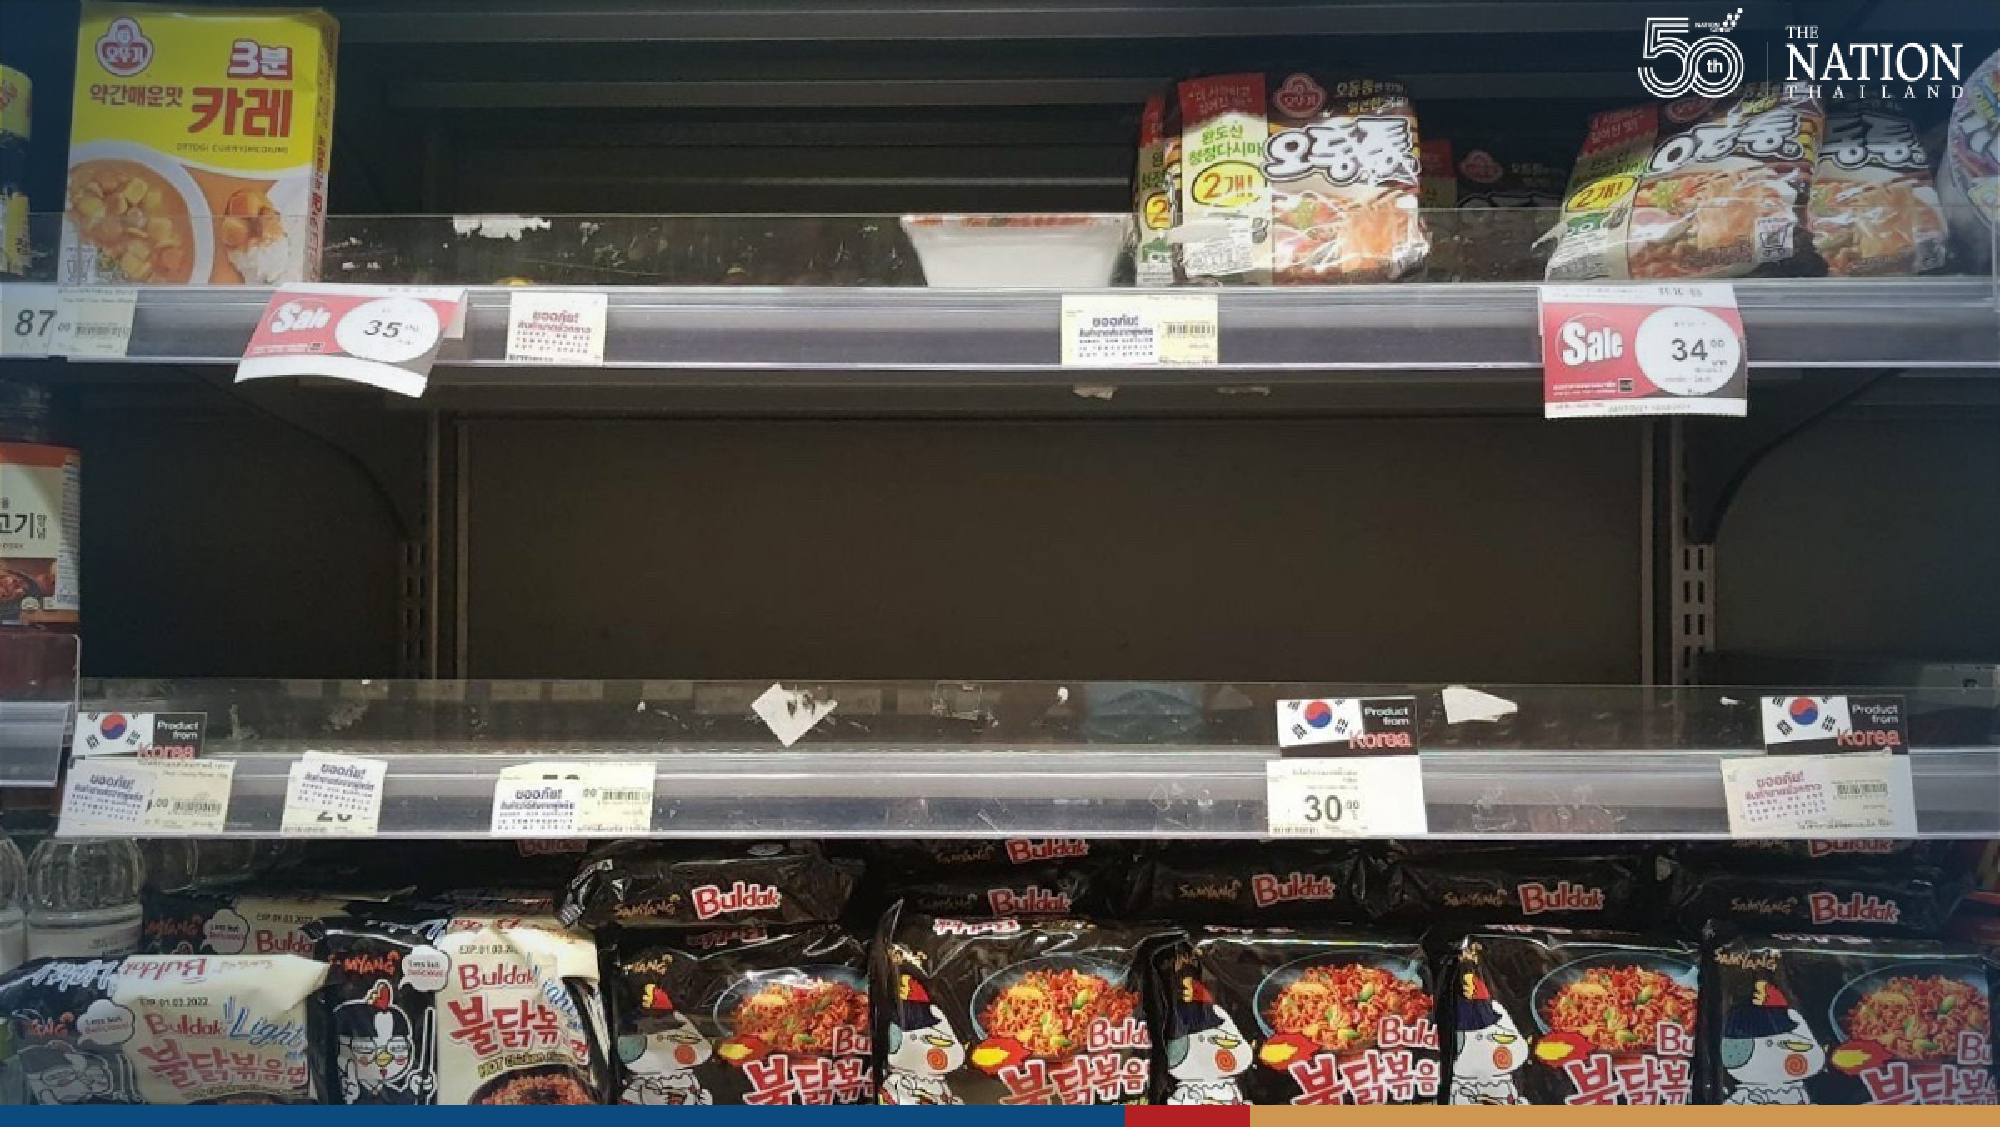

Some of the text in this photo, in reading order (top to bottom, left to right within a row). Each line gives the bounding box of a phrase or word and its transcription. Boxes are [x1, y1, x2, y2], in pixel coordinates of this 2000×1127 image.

[228, 39, 293, 80] 3분
[89, 84, 183, 107] 약간매운맛
[188, 87, 293, 138] 카레
[1203, 173, 1253, 198] 2개!
[14, 309, 58, 337] 87
[271, 301, 332, 334] Sale
[363, 320, 403, 338] 35
[1562, 321, 1623, 366] Sale
[1671, 338, 1708, 361] 34
[1364, 706, 1409, 716] Product
[1383, 717, 1411, 726] from
[1852, 704, 1898, 714] Product
[1872, 714, 1899, 724] from
[157, 721, 199, 731] Product
[173, 730, 198, 740] from
[1348, 729, 1412, 750] Korea
[1837, 728, 1902, 747] Korea
[137, 743, 195, 760] Korea
[1304, 794, 1360, 823] 30 00
[1006, 839, 1089, 863] Buldak
[692, 881, 781, 920] Buldak
[988, 885, 1073, 916] Buldak
[1252, 872, 1336, 907] Buldak
[1517, 880, 1605, 915] Buldak
[1809, 891, 1901, 925] Buldak
[458, 962, 533, 990] Buldak
[143, 1006, 307, 1046] Buldak Light
[833, 1025, 872, 1056] Bu
[137, 1039, 308, 1089] 불닭볶음면
[998, 1052, 1151, 1104] 불닭볶음
[1288, 1050, 1440, 1104] 불닭볶음
